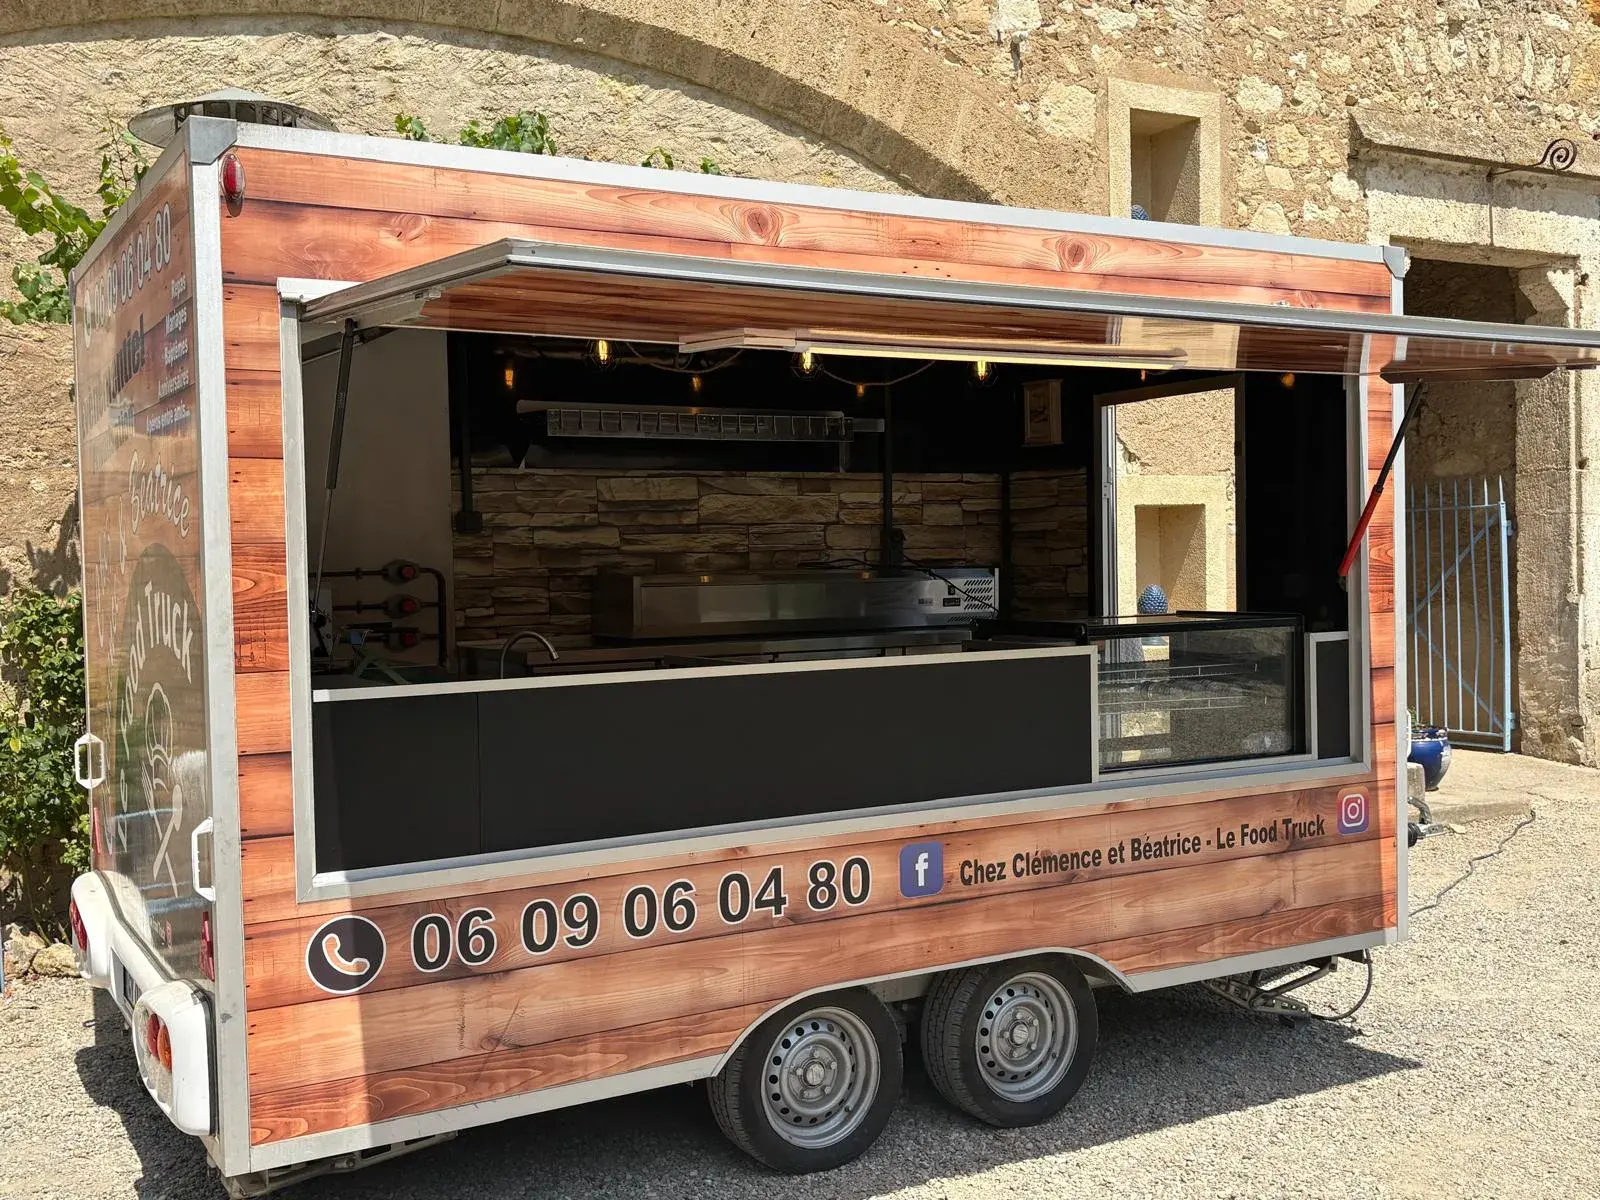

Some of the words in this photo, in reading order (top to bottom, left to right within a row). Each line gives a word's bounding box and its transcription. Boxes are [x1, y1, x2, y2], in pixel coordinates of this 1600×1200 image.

[107, 261, 118, 319] 09
[120, 243, 134, 305] 06
[137, 221, 152, 290] 04
[155, 201, 171, 273] 80
[129, 449, 190, 537] Béatrice
[120, 601, 146, 761] Food
[145, 580, 194, 684] Truck
[960, 859, 1006, 886] Chez
[1012, 847, 1101, 877] Clémence
[1107, 840, 1125, 864] et
[1131, 834, 1201, 861] Béatrice
[1217, 828, 1235, 850] Le
[1240, 820, 1278, 845] Food
[1282, 815, 1325, 840] Truck
[410, 907, 497, 972] 06
[520, 892, 599, 956] 09
[622, 878, 697, 939] 06
[717, 866, 787, 924] 04
[806, 855, 872, 912] 80
